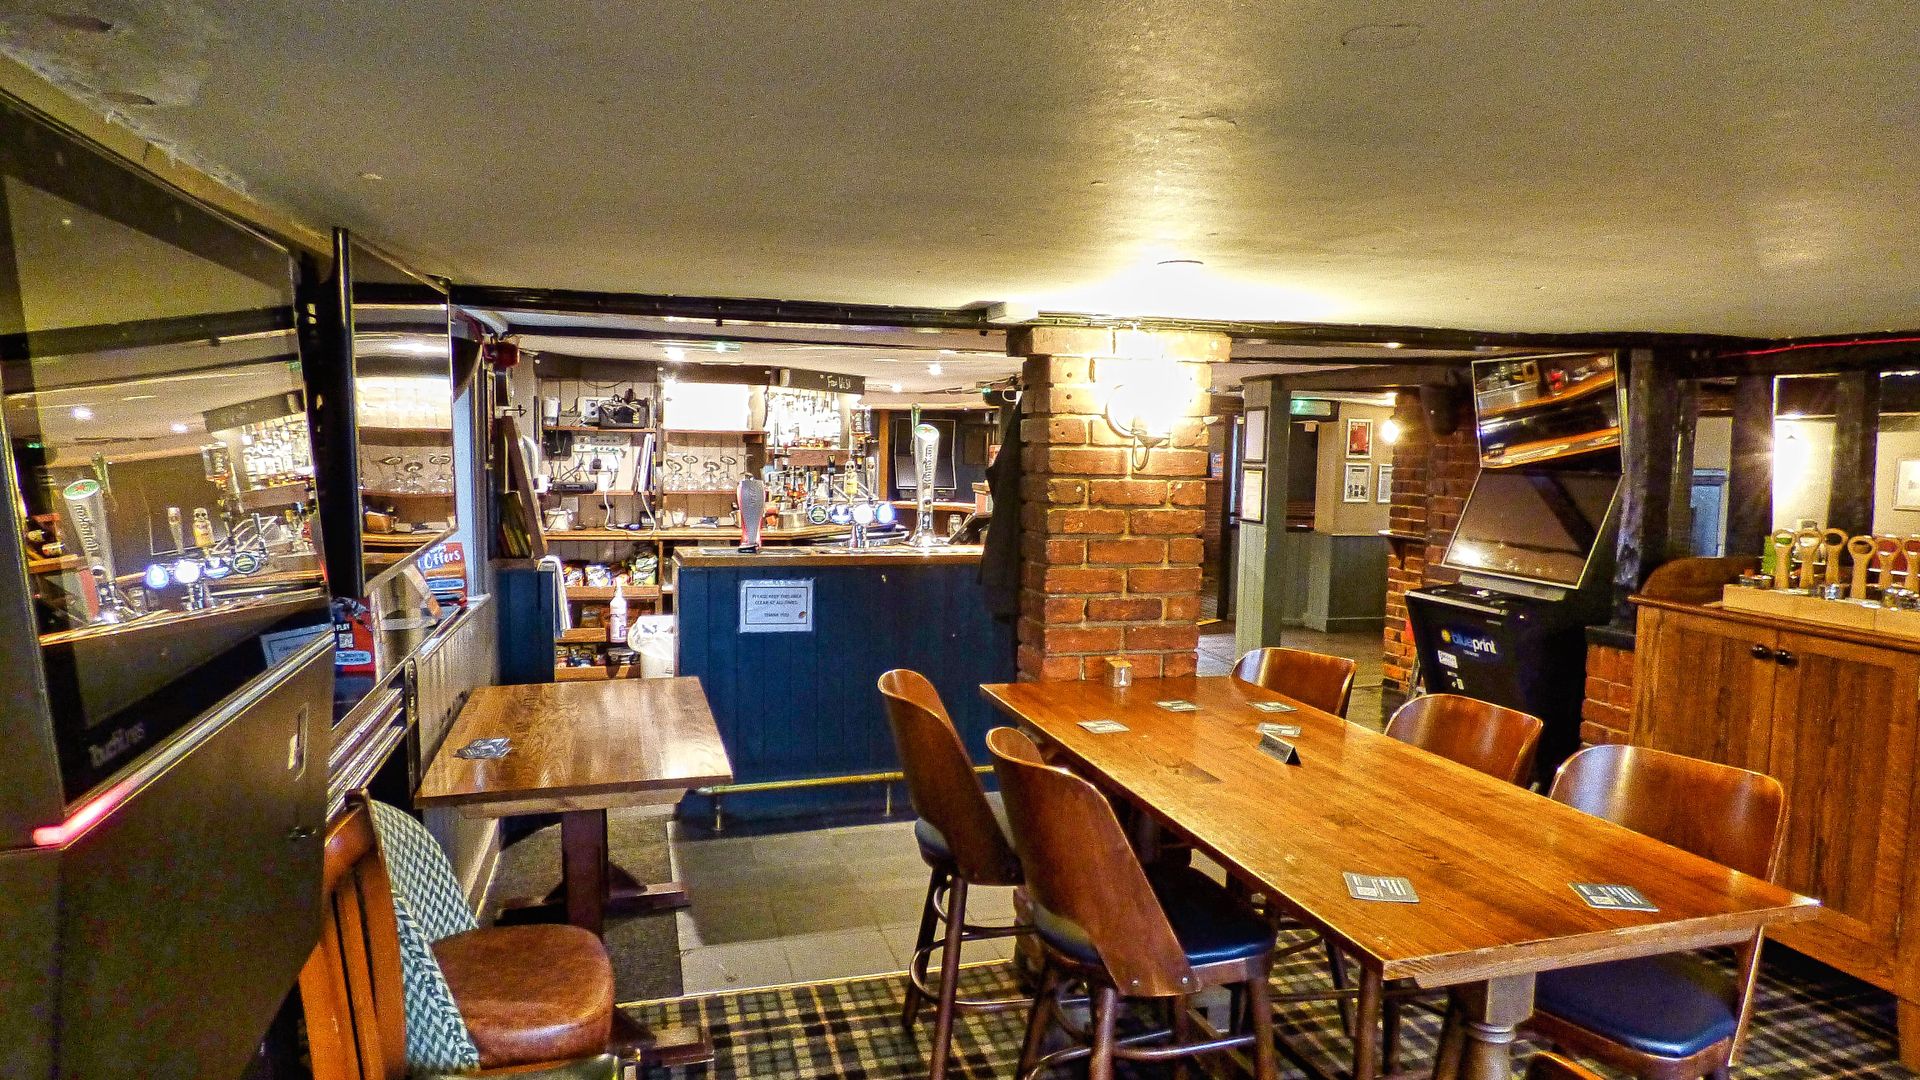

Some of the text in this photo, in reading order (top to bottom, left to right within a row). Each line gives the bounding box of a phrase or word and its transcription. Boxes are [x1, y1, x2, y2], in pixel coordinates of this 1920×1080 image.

[424, 550, 461, 569] Offers
[1451, 632, 1497, 655] blueprint
[1119, 667, 1128, 686] 1
